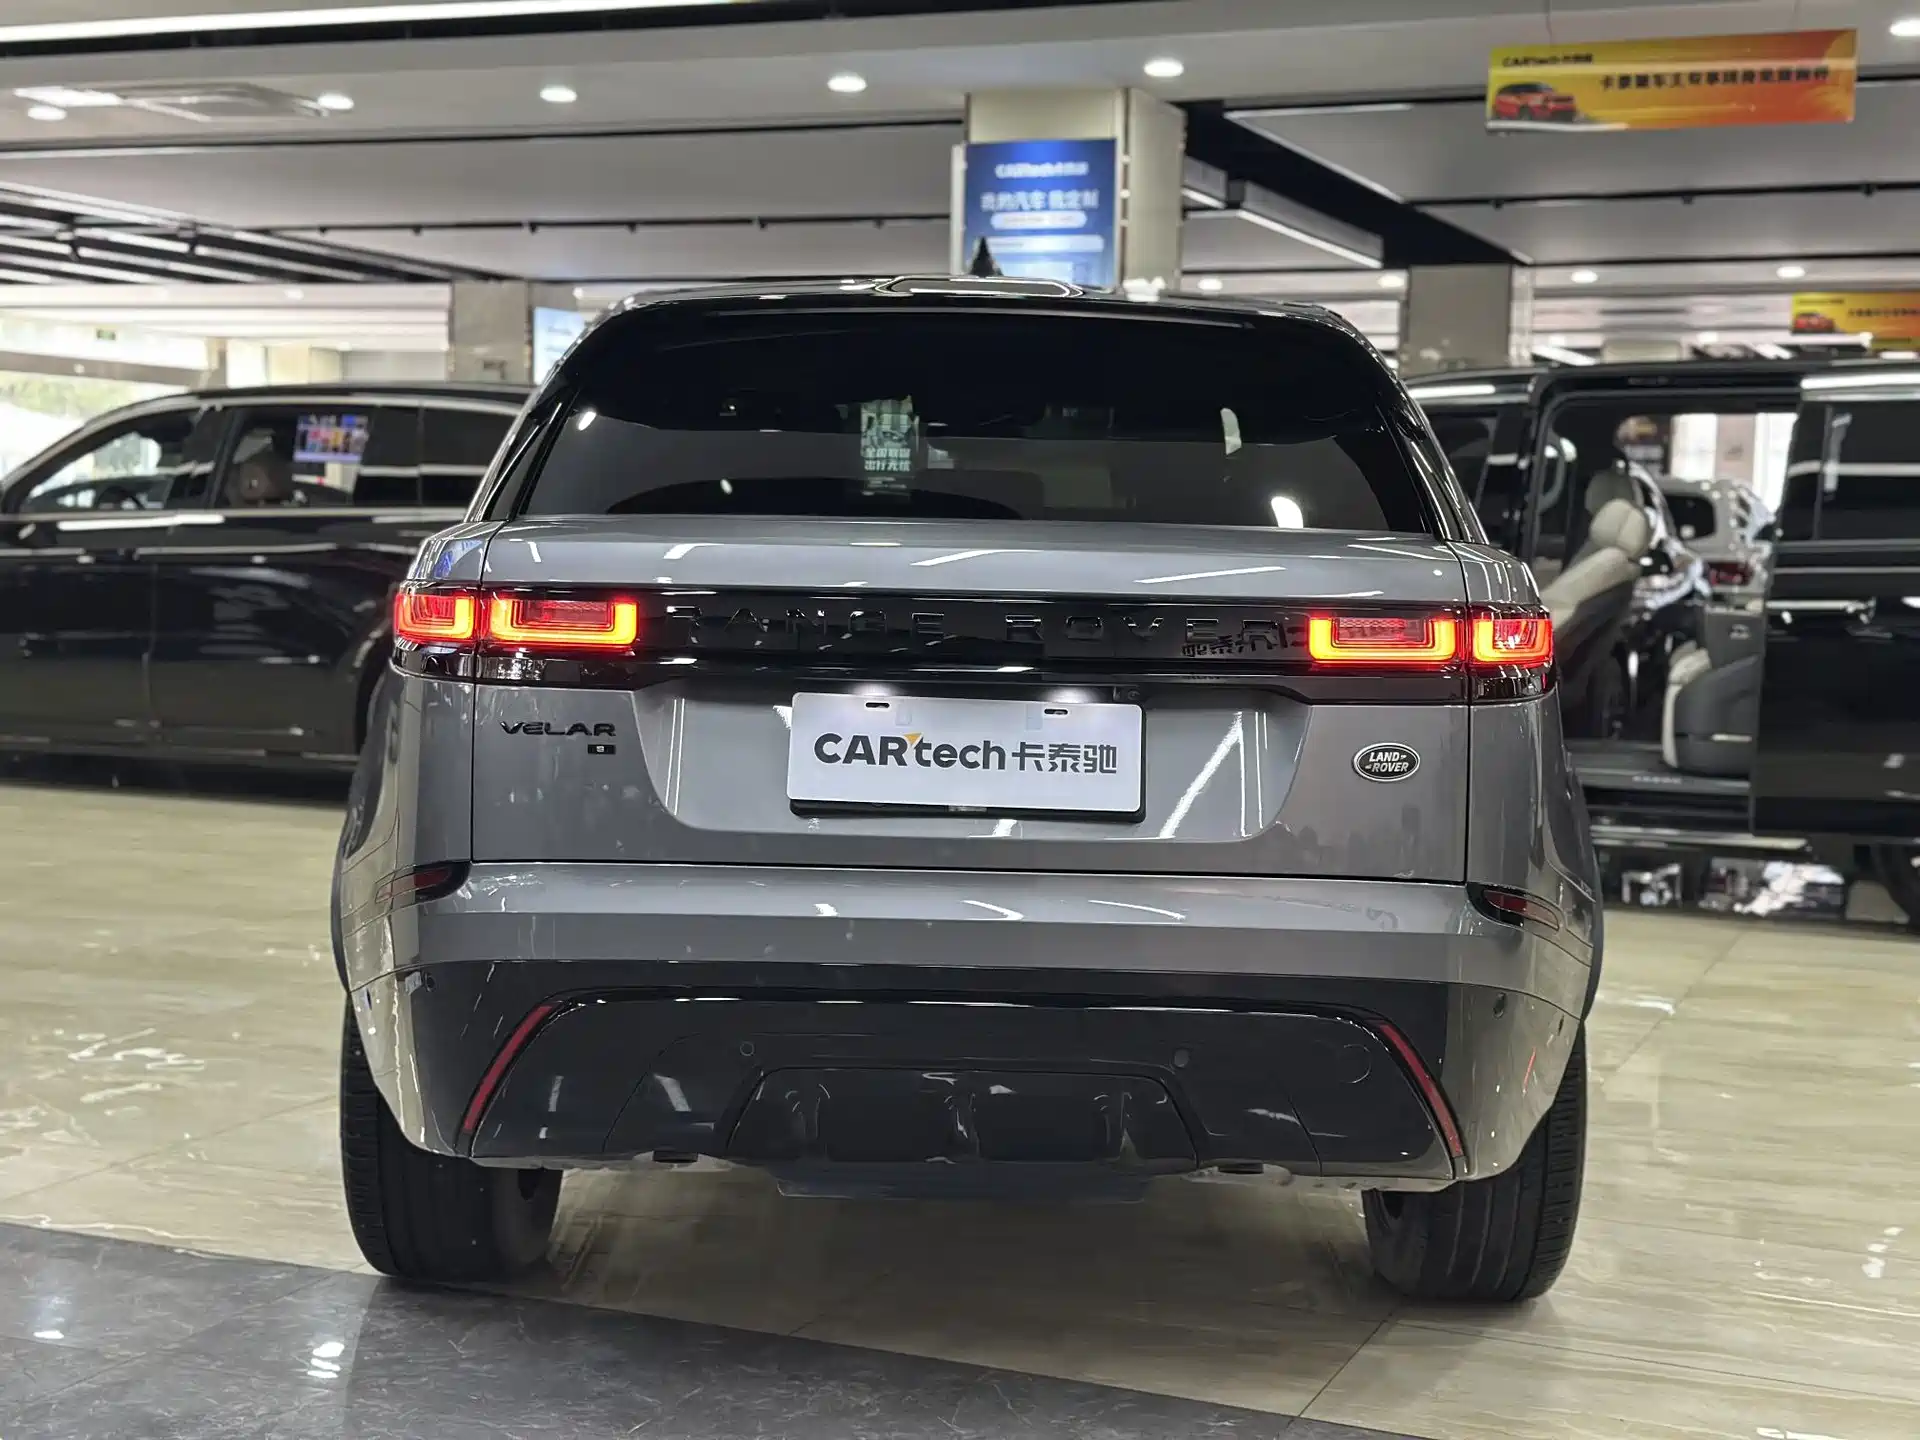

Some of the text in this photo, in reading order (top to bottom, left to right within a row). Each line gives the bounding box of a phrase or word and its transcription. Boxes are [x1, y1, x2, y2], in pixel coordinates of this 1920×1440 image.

[665, 605, 1279, 645] RANGE ROVER
[499, 720, 616, 737] VELAR
[1369, 751, 1400, 762] LAND
[1371, 762, 1409, 773] ROVER
